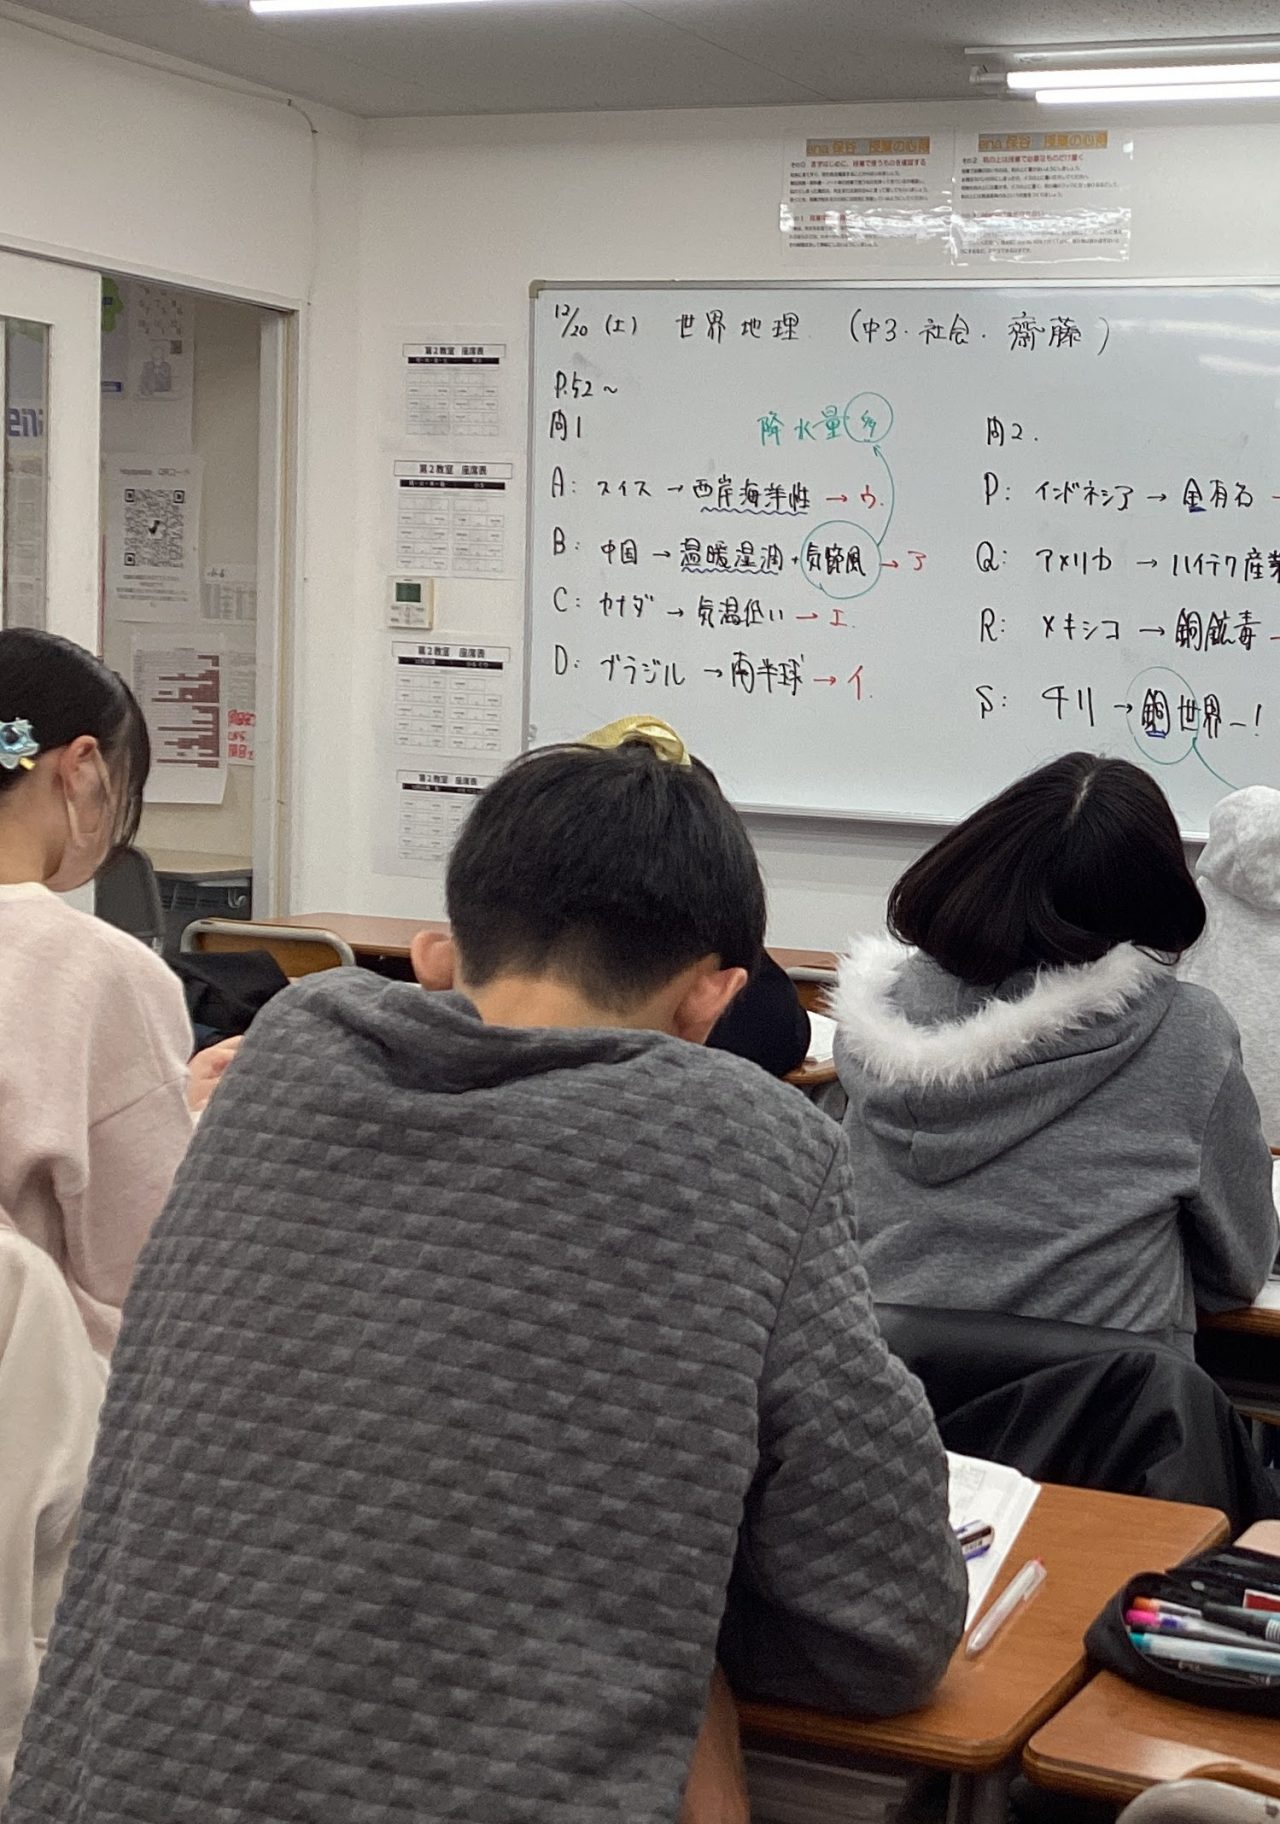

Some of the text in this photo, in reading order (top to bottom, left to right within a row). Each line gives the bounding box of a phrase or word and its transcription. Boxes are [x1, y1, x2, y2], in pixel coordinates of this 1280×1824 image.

[555, 303, 588, 338] 12/20
[605, 313, 637, 336] (土)
[675, 309, 800, 343] 世界地理
[550, 409, 581, 441] 問1
[552, 466, 576, 498] A:
[598, 480, 651, 497] スイス
[693, 474, 810, 511] 西岸海洋性
[984, 471, 1011, 505] P:
[1035, 480, 1134, 511] インドネシア
[553, 527, 581, 556] B:
[600, 538, 638, 566] 中国
[976, 541, 1007, 572] Q:
[1036, 547, 1112, 575] アメリカ
[553, 586, 581, 612] C:
[600, 592, 654, 618] カナダ
[698, 595, 784, 629] 気温低い
[980, 608, 1005, 642] R:
[1043, 613, 1120, 641] メキシコ
[555, 645, 580, 675] D:
[601, 654, 685, 687] ブラジル
[732, 651, 804, 696] 南半球
[1041, 685, 1094, 727] チリ
